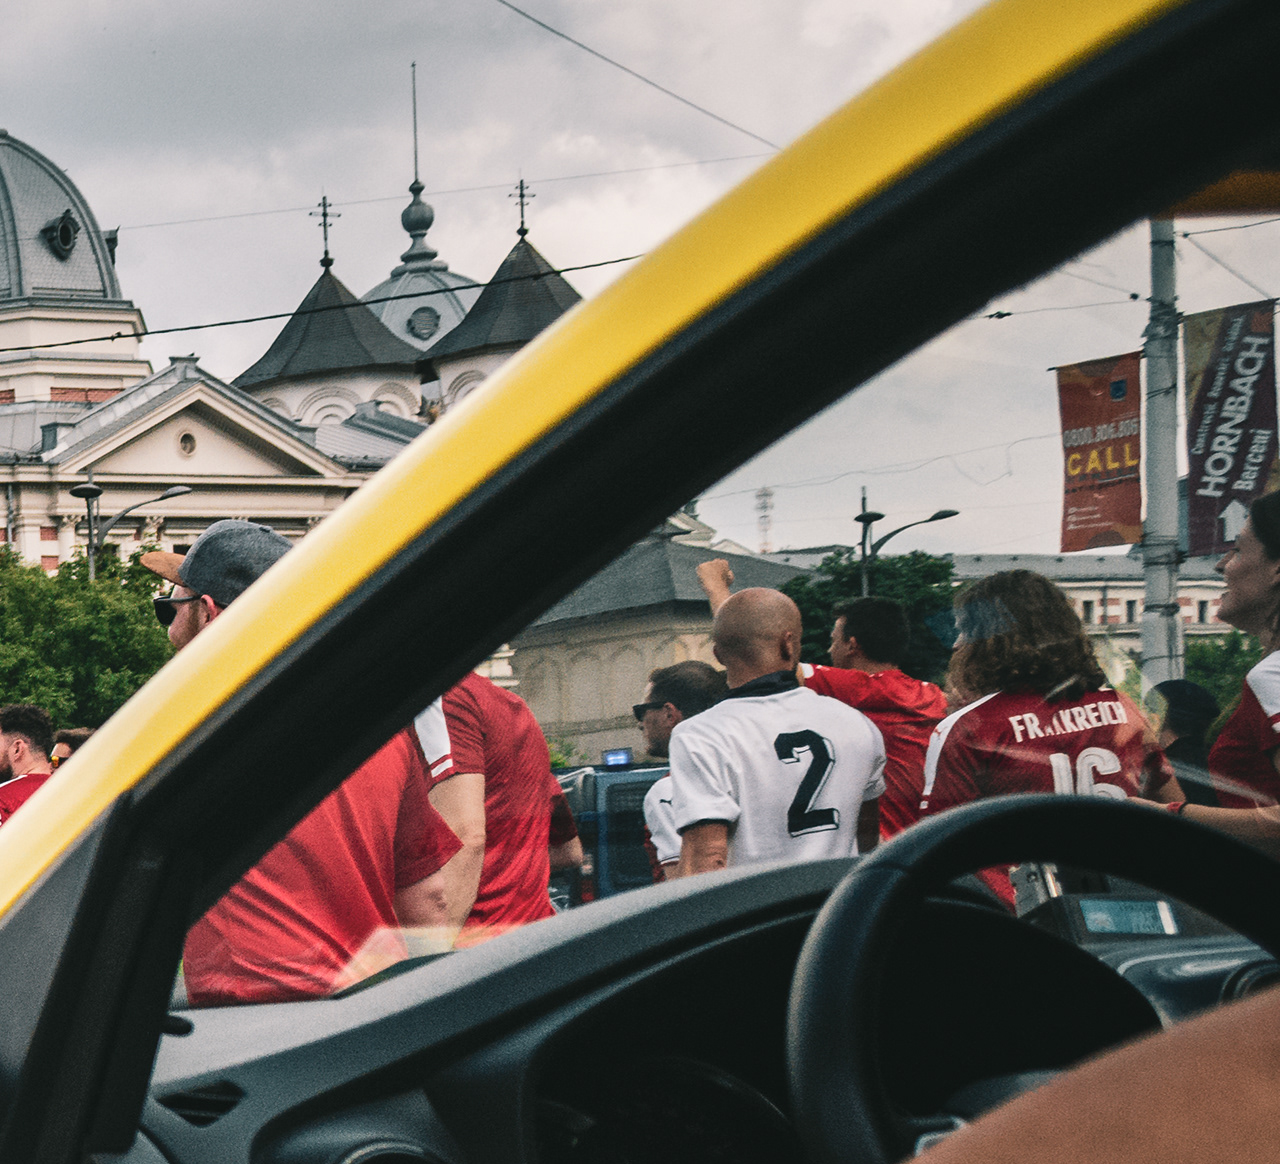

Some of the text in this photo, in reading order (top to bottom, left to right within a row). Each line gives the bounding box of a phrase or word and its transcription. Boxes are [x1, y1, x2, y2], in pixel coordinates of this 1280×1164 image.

[1196, 334, 1271, 498] HORNBACH
[1067, 442, 1140, 476] CALL
[1232, 428, 1274, 491] Berceni
[774, 729, 841, 838] 2
[1049, 747, 1128, 800] 16
